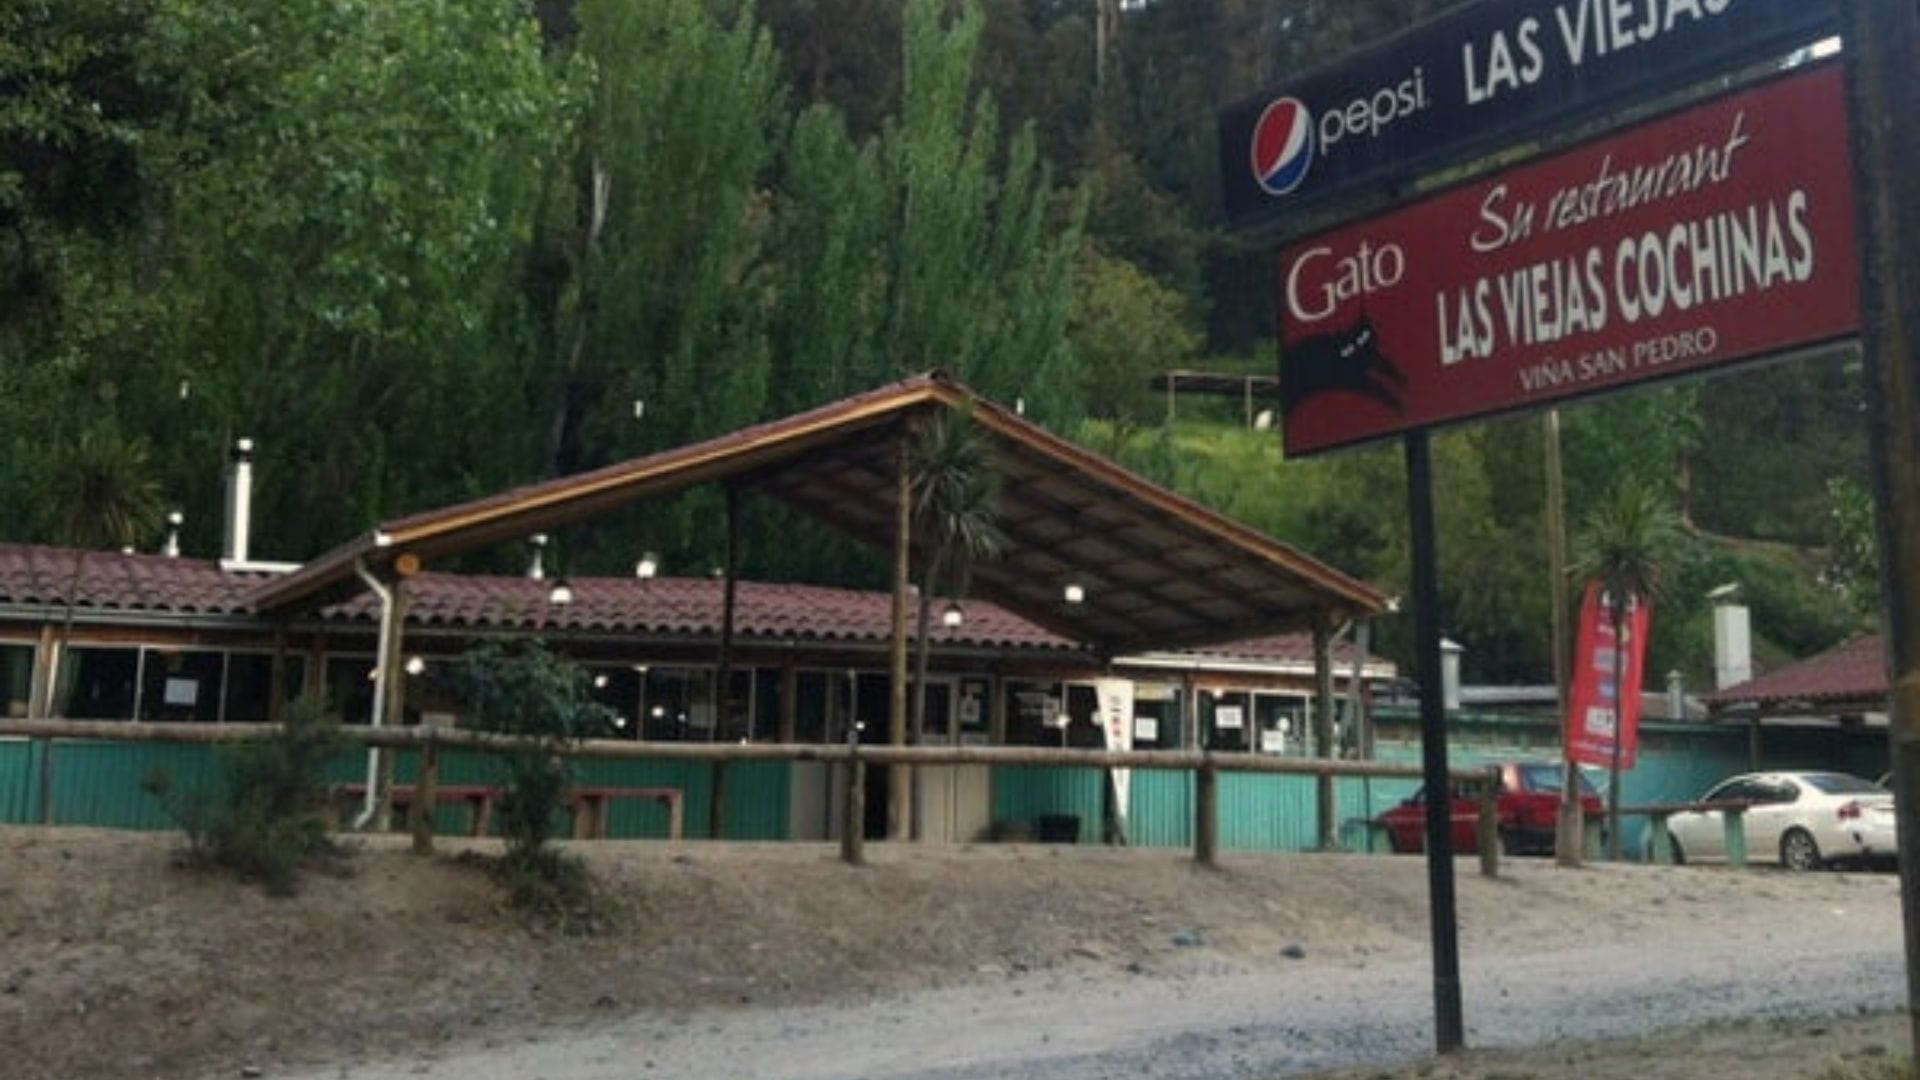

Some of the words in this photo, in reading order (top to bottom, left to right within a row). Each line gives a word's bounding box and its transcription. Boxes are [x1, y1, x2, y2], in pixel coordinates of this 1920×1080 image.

[1463, 17, 1544, 105] LAS
[1555, 0, 1728, 66] VIEJ
[1319, 67, 1426, 156] pepsi
[1470, 185, 1536, 253] Su
[1541, 111, 1749, 231] restaurant
[1286, 241, 1404, 322] Gato
[1438, 278, 1496, 364] LAS
[1499, 248, 1606, 345] VIEJAS
[1615, 190, 1812, 323] COCHINAS
[1519, 356, 1575, 392] VIÑA
[1579, 347, 1627, 378] SAN
[1633, 327, 1717, 367] PEDRO
